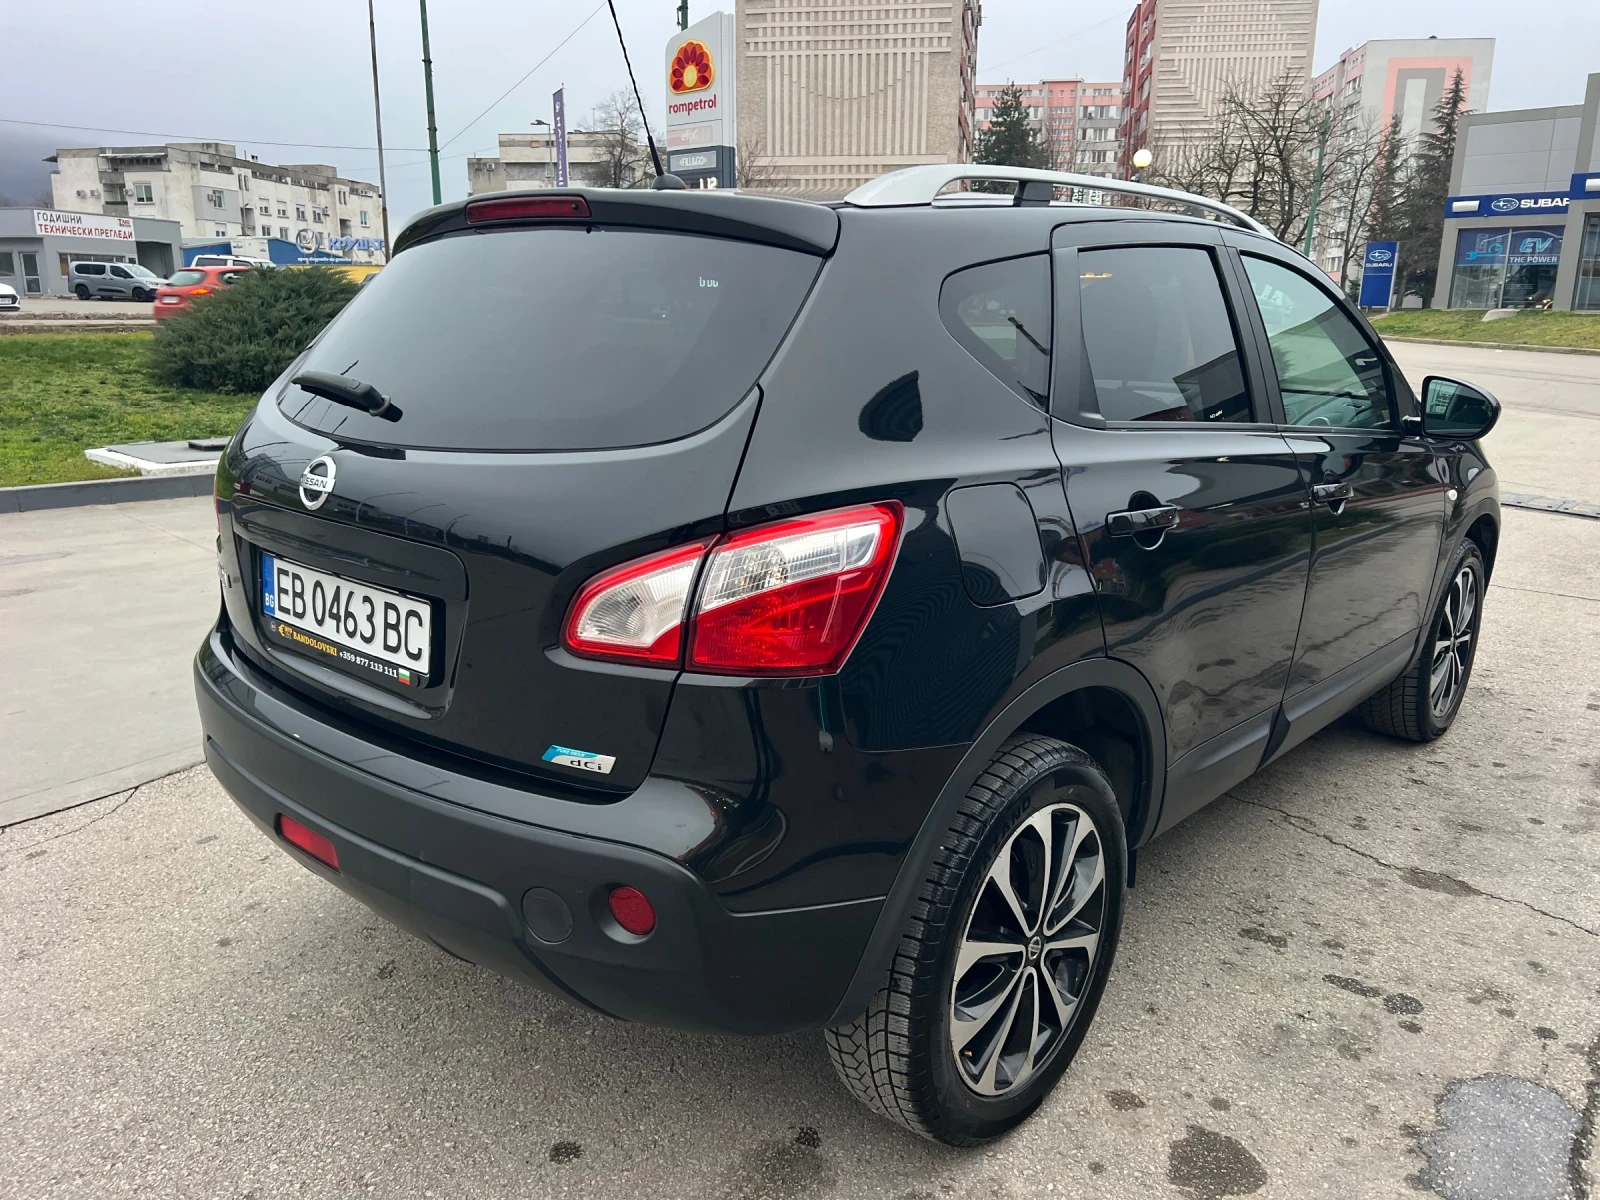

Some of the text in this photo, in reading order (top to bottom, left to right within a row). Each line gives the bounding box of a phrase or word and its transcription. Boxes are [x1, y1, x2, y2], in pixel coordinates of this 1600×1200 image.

[669, 94, 717, 116] rompetrol
[681, 129, 698, 144] efix
[37, 212, 82, 224] ГОДИШНИ
[38, 224, 133, 240] ТЕХНИЧЕСКИ ПРЕГЛЕДИ
[1520, 238, 1554, 253] EV
[265, 592, 275, 608] BG
[277, 567, 306, 620] EB
[312, 580, 376, 644] 0463
[383, 601, 423, 661] BC
[293, 631, 338, 656] BANDOLOVSKI
[339, 651, 355, 662] +359
[356, 656, 369, 667] 877
[370, 661, 383, 672] 113
[384, 666, 398, 678] 111
[570, 759, 602, 770] dCi
